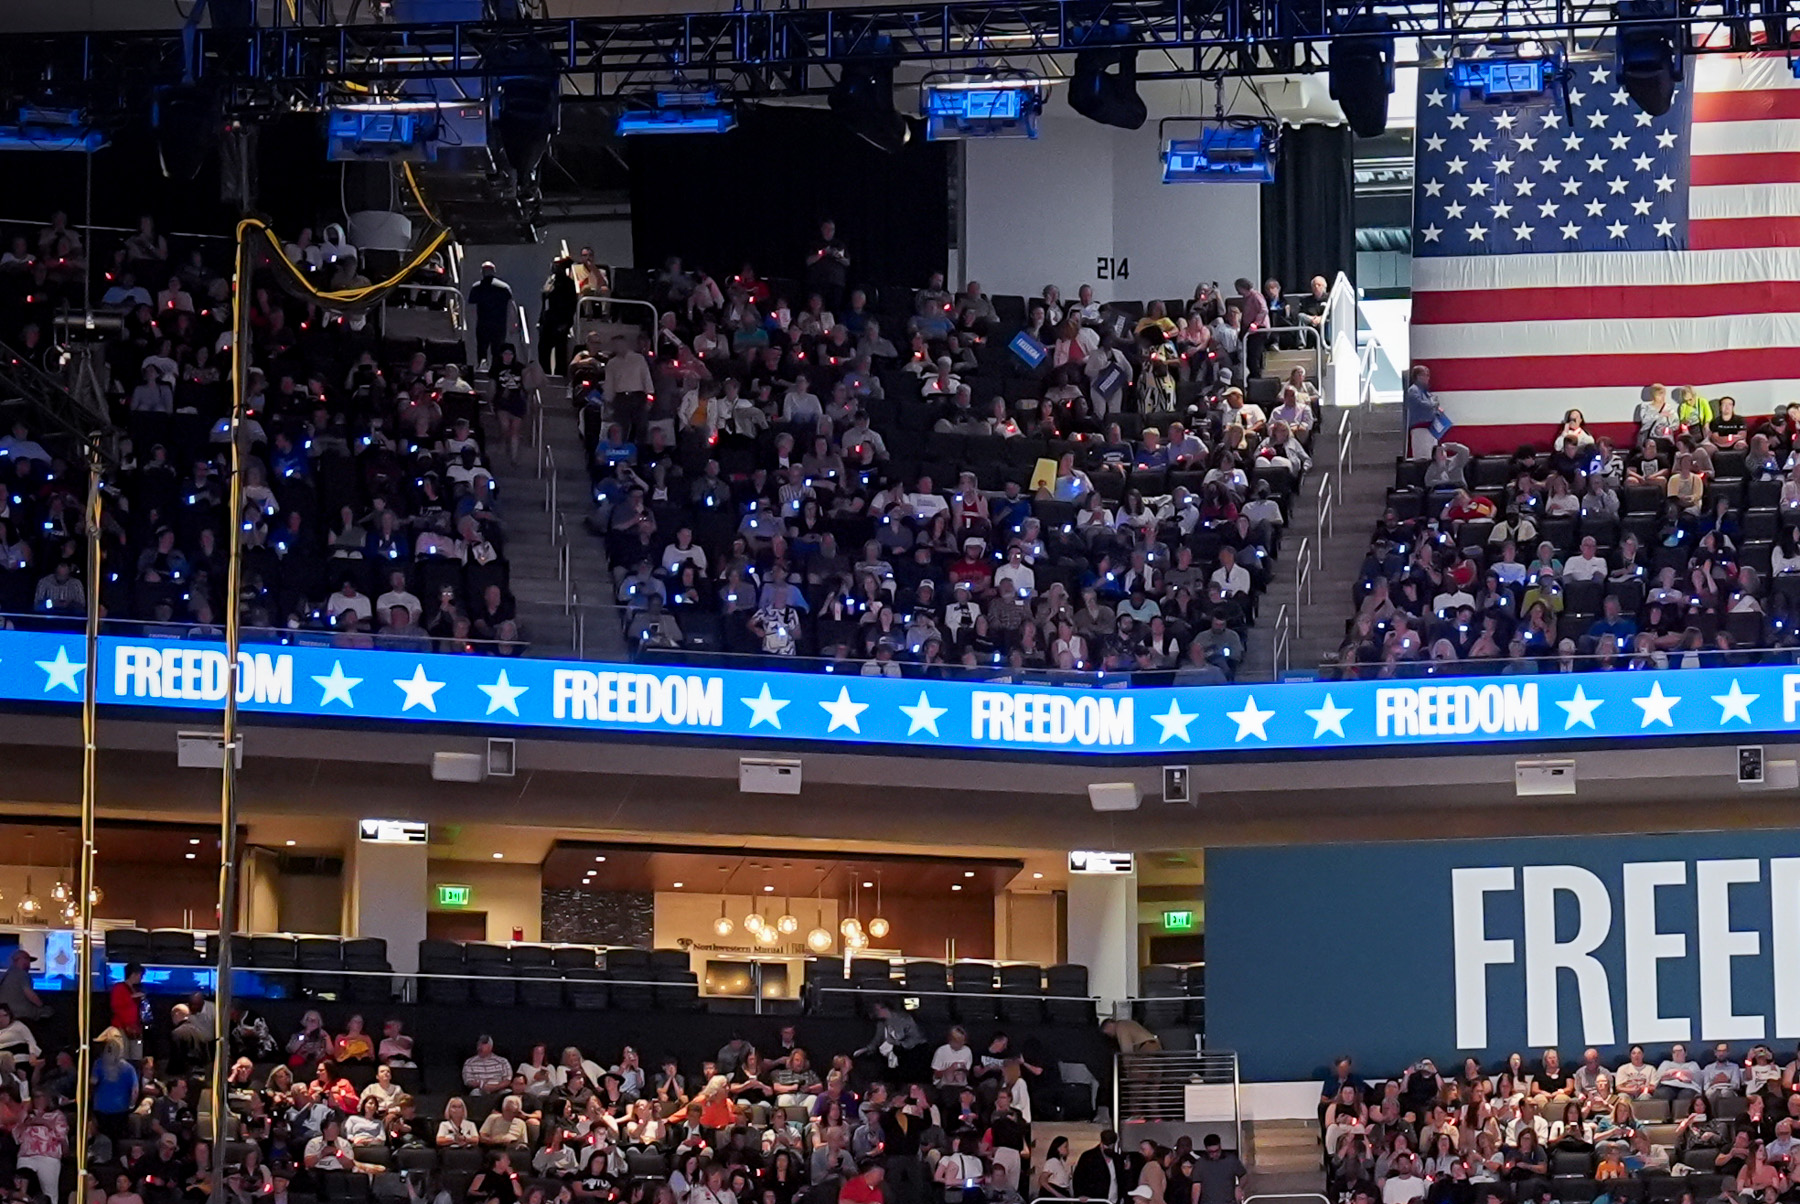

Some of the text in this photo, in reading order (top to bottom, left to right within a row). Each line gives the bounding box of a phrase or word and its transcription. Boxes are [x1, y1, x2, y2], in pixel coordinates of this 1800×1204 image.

[1097, 257, 1130, 280] 214
[116, 647, 292, 703] FREEDOM
[555, 671, 722, 725] FREEDOM
[973, 692, 1133, 744] FREEDOM
[1378, 684, 1538, 735] FREEDOM
